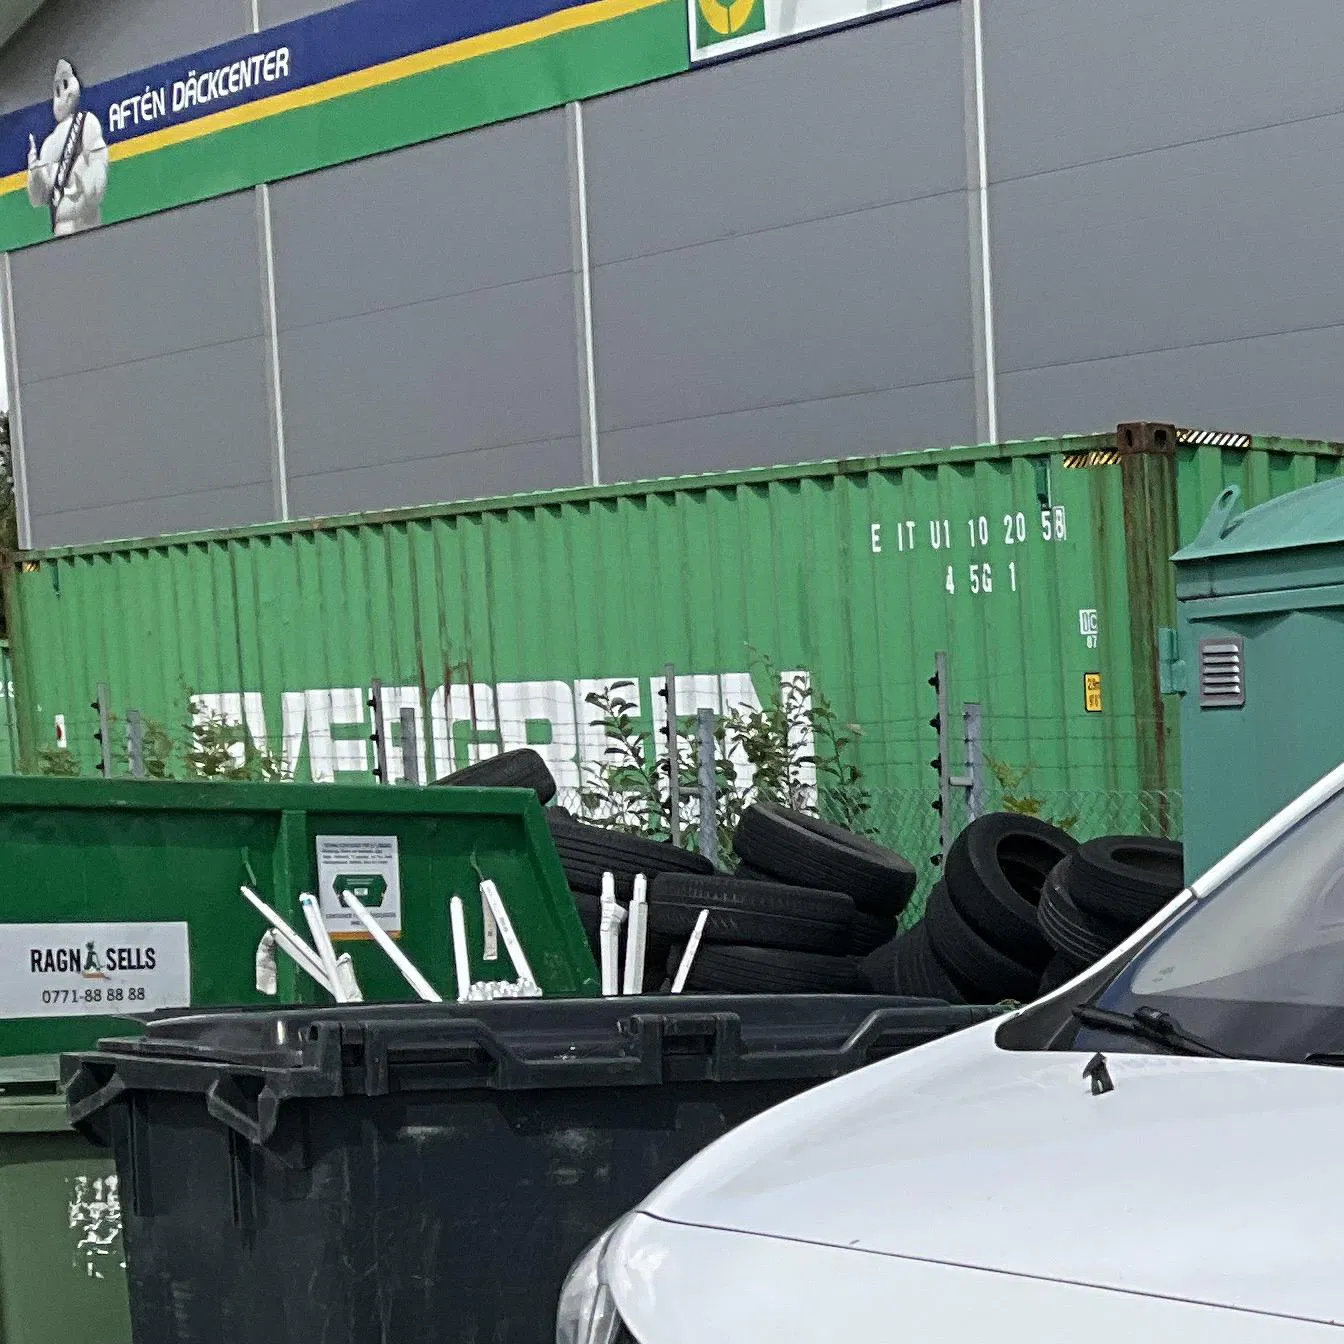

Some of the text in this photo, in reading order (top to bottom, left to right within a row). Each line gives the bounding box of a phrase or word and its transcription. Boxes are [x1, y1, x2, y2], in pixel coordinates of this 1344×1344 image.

[109, 47, 290, 132] AFTÉN DÄCKCENTER
[30, 947, 156, 973] RAGN SELLS
[42, 987, 146, 1004] 0771-88 88 88
